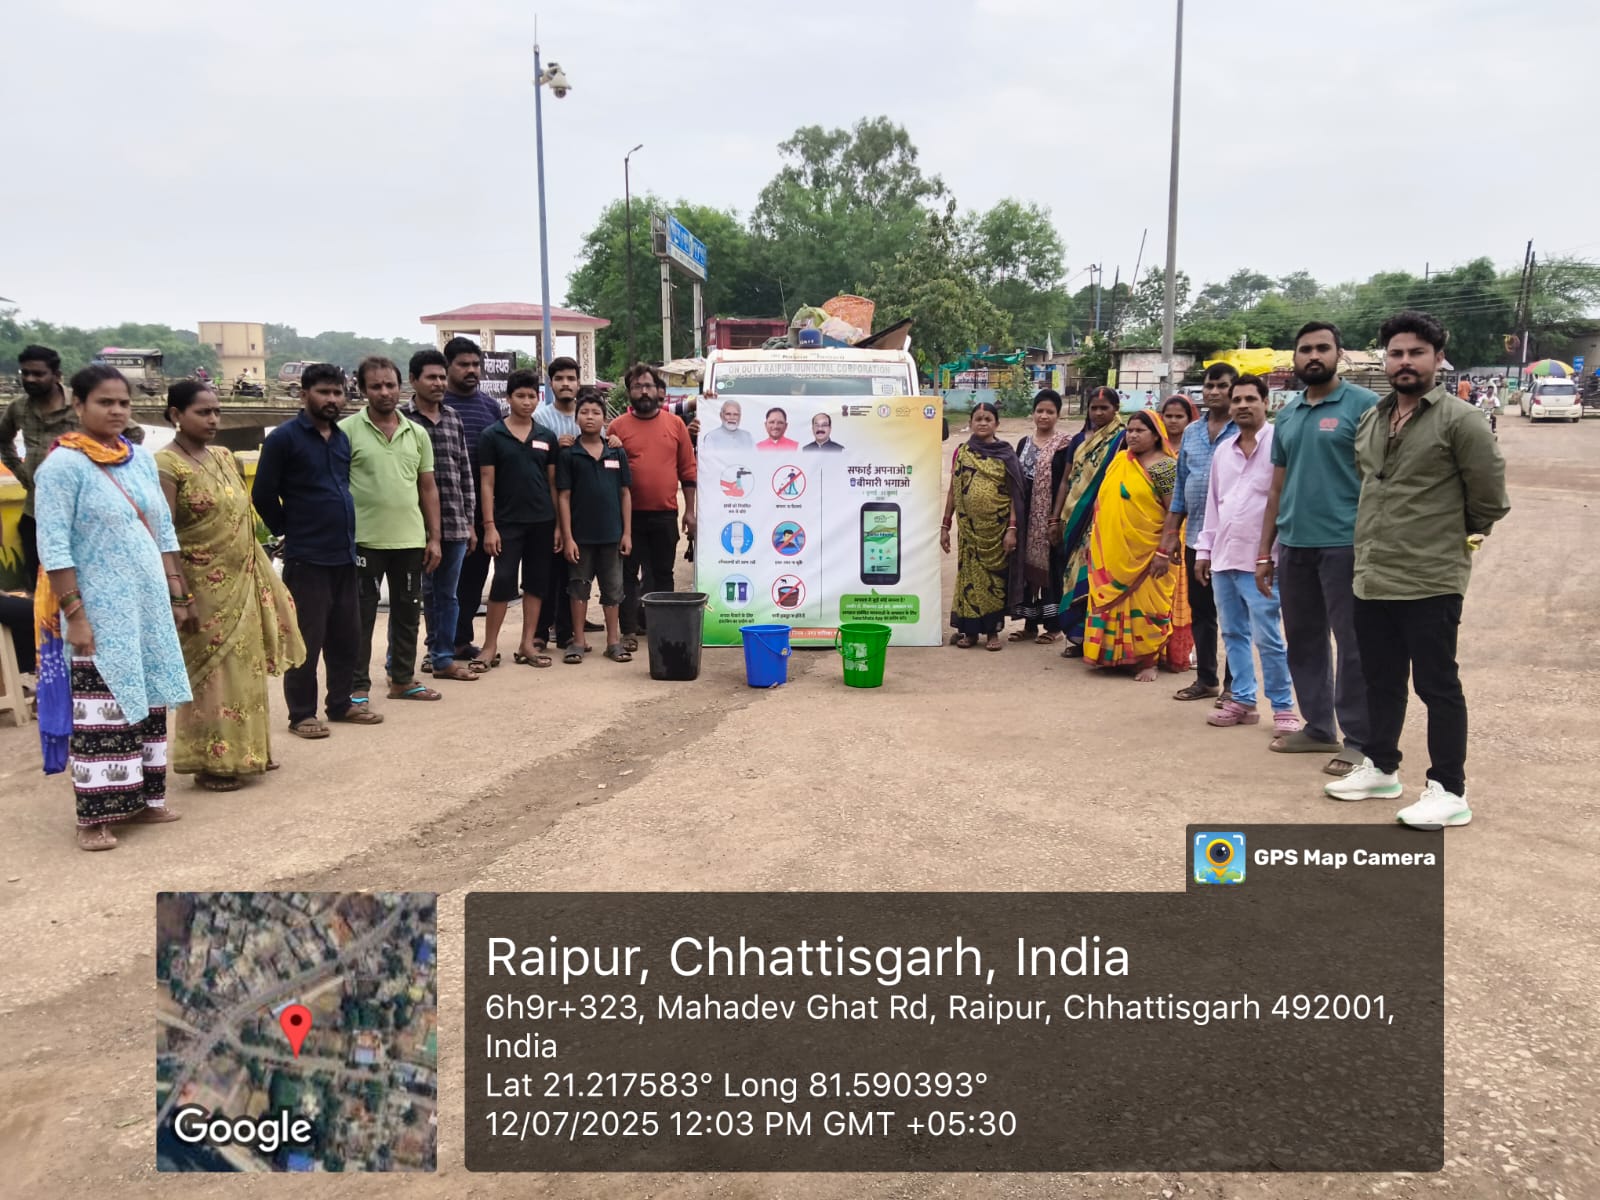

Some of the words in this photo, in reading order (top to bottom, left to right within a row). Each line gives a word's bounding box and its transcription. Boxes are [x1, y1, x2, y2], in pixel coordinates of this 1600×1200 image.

[728, 365, 740, 374] ON
[742, 364, 762, 374] DUTY
[764, 364, 792, 373] RAIPUR
[794, 363, 834, 373] MUNICIPAL
[836, 363, 891, 374] CORPORATION
[847, 464, 872, 476] सफाई
[874, 464, 906, 475] अपनाओ
[857, 477, 882, 487] बीमारी
[884, 477, 911, 487] भगाओ
